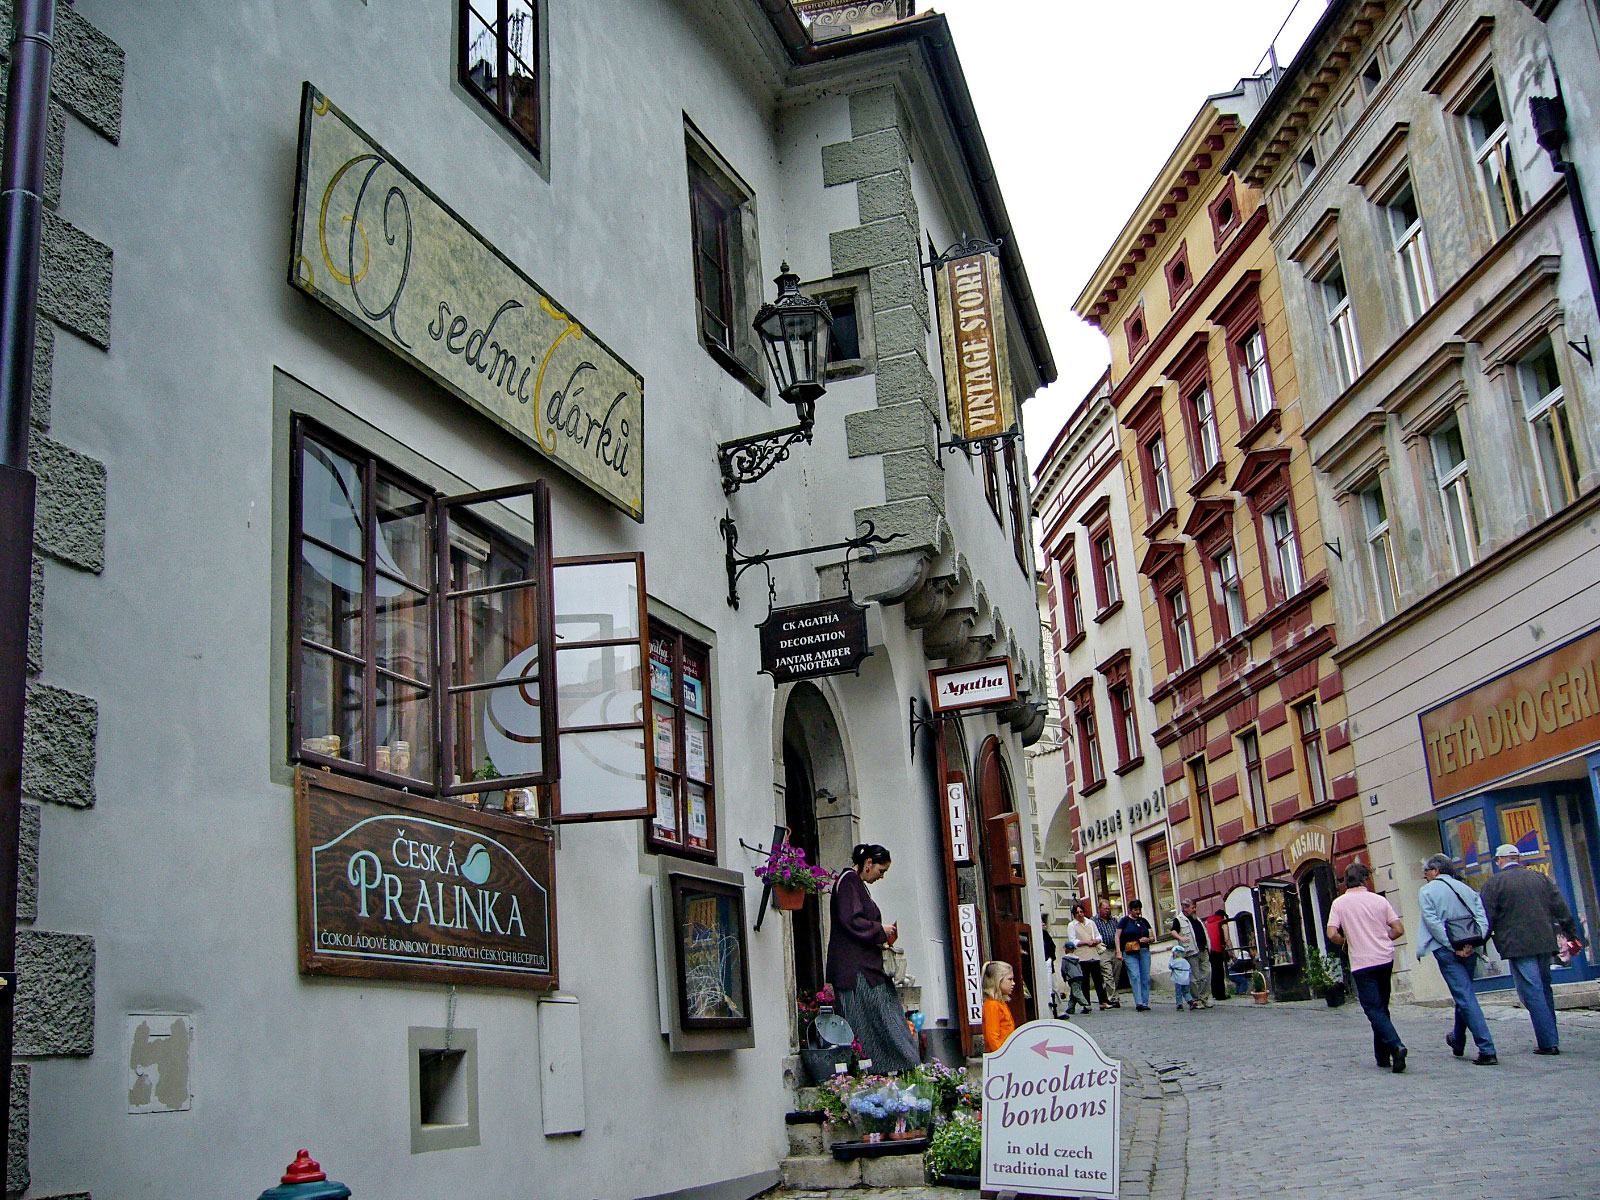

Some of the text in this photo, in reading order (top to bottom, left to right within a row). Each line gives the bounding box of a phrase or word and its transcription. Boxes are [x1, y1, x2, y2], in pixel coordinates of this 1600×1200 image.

[954, 261, 997, 433] VINTAGE STORE
[427, 299, 536, 405] sedmi
[546, 361, 629, 478] dárků
[779, 630, 846, 649] DECORATION
[782, 613, 840, 631] CK AGATHA
[775, 646, 851, 668] JANTAR AMBER
[788, 657, 841, 674] VINOTEKA
[942, 676, 1005, 696] Agatha
[1428, 658, 1600, 778] TETA DROGERI
[949, 787, 965, 857] GIFT
[1505, 809, 1535, 845] TETA
[392, 828, 459, 877] ČESKÁ
[1290, 831, 1326, 864] MOSAIKA
[347, 850, 527, 938] PRALINKA
[321, 928, 546, 966] ČOKOLÁDOVÉ BONBONY DLE STARÝCH ČESKÝCH RECEPTUR
[961, 906, 982, 1020] SOUVENIR
[984, 1064, 1119, 1101] Chocolates
[1001, 1095, 1107, 1128] bonbons
[1007, 1141, 1094, 1160] in old czech
[993, 1160, 1108, 1181] traditional taste
